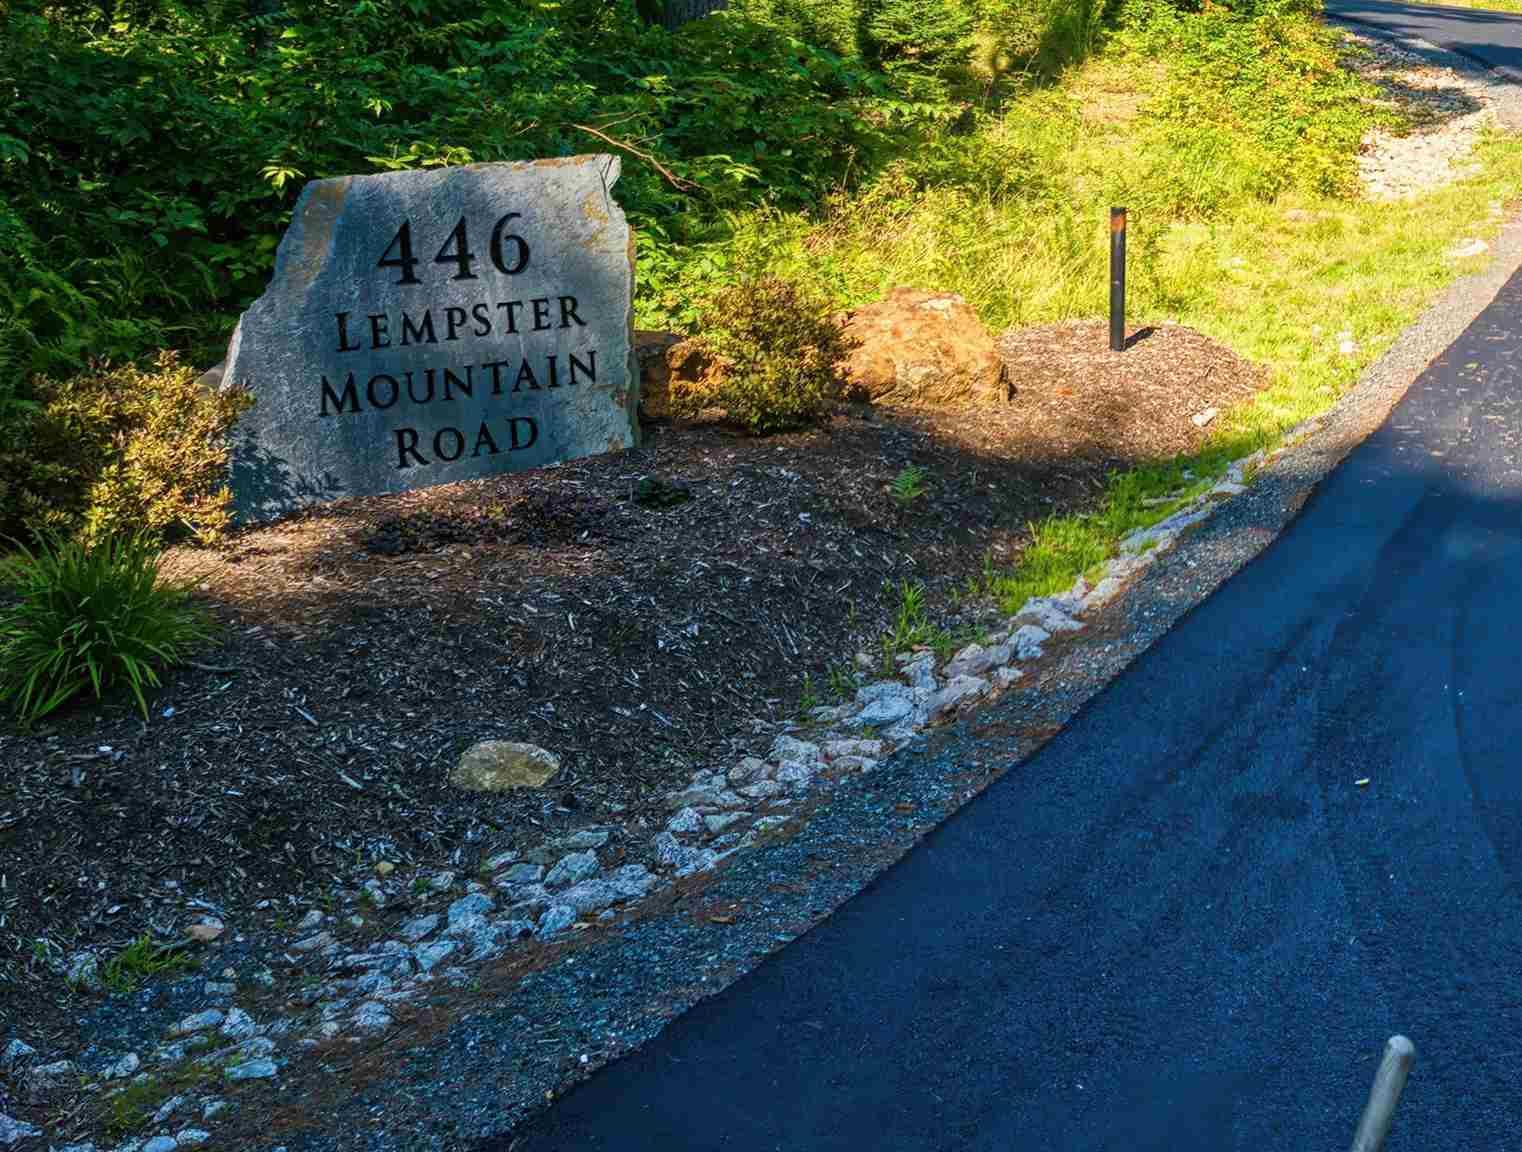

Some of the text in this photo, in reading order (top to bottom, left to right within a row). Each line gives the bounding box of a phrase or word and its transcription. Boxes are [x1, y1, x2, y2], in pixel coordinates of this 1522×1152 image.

[377, 212, 531, 285] 446
[335, 295, 587, 353] LEMPSTER
[320, 350, 599, 417] MOUNTAIN
[394, 416, 539, 470] ROAD
